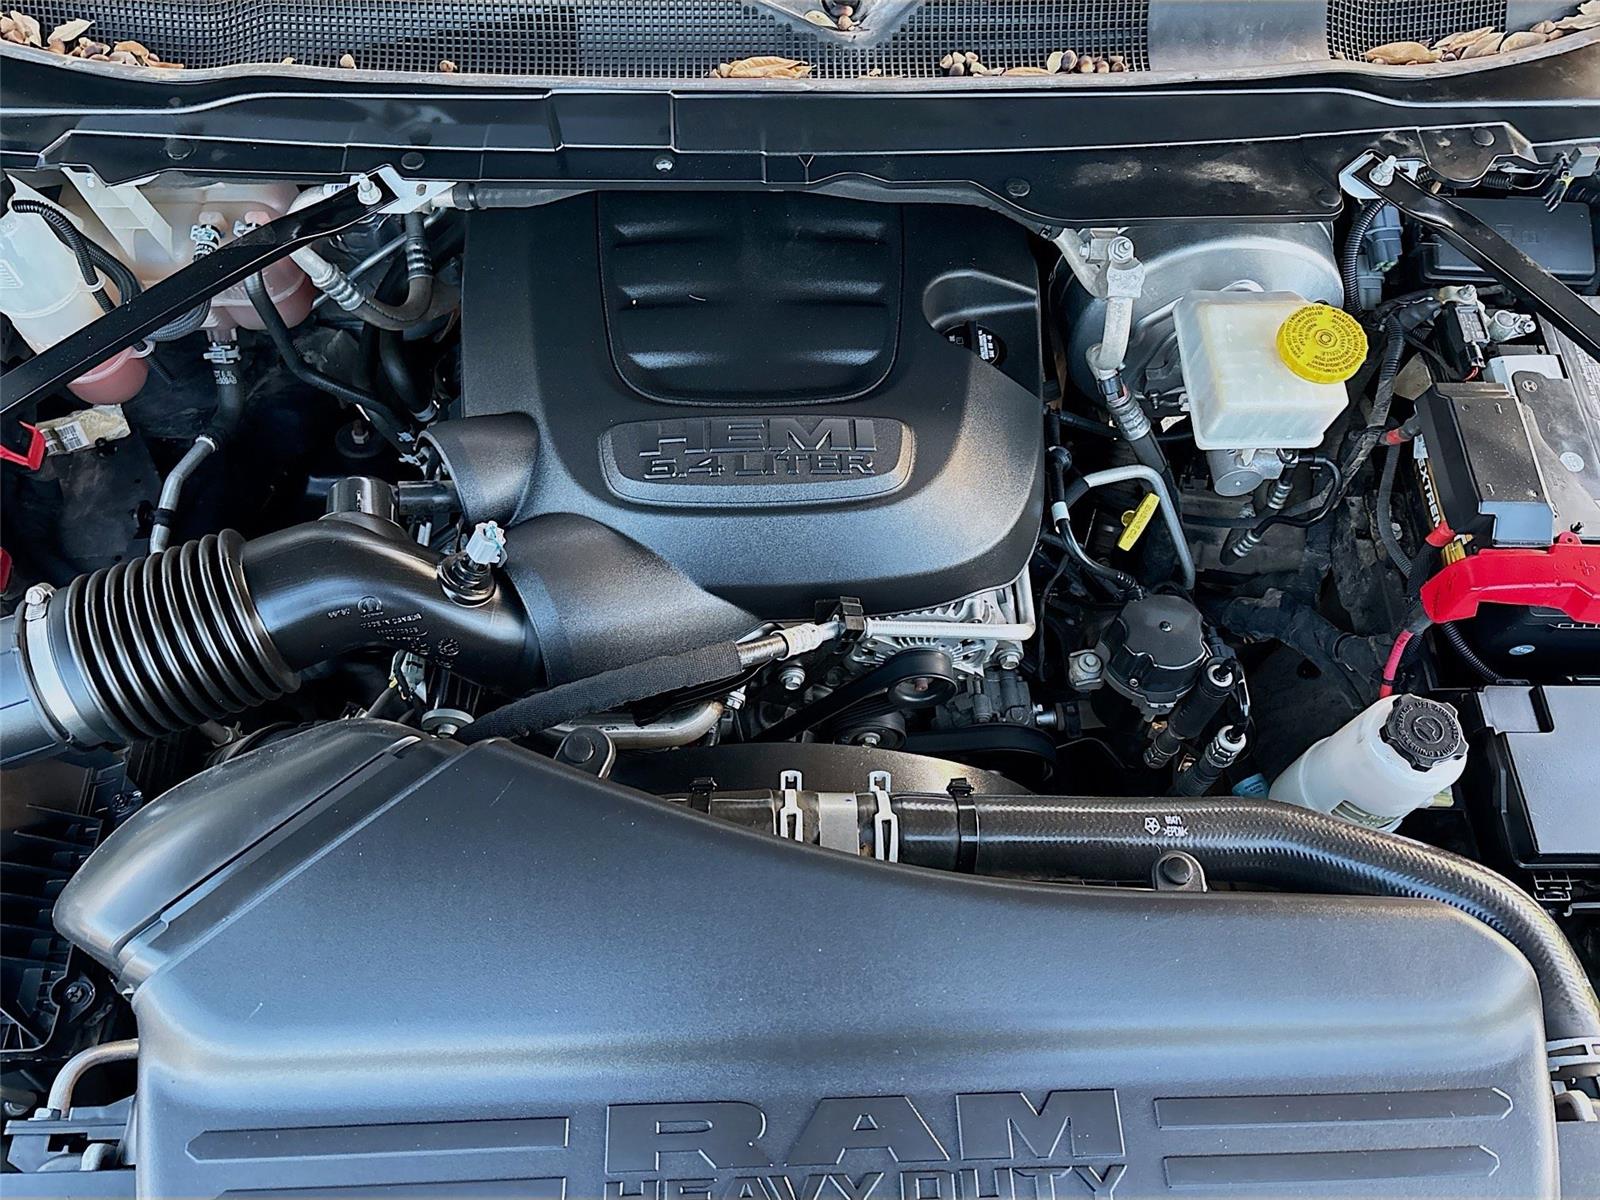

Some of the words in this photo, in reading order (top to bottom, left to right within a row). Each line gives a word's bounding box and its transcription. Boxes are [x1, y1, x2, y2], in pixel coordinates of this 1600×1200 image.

[639, 416, 877, 457] HEMI
[643, 453, 725, 479] 6.4
[735, 451, 876, 476] LITER
[605, 1088, 1127, 1174] RAM
